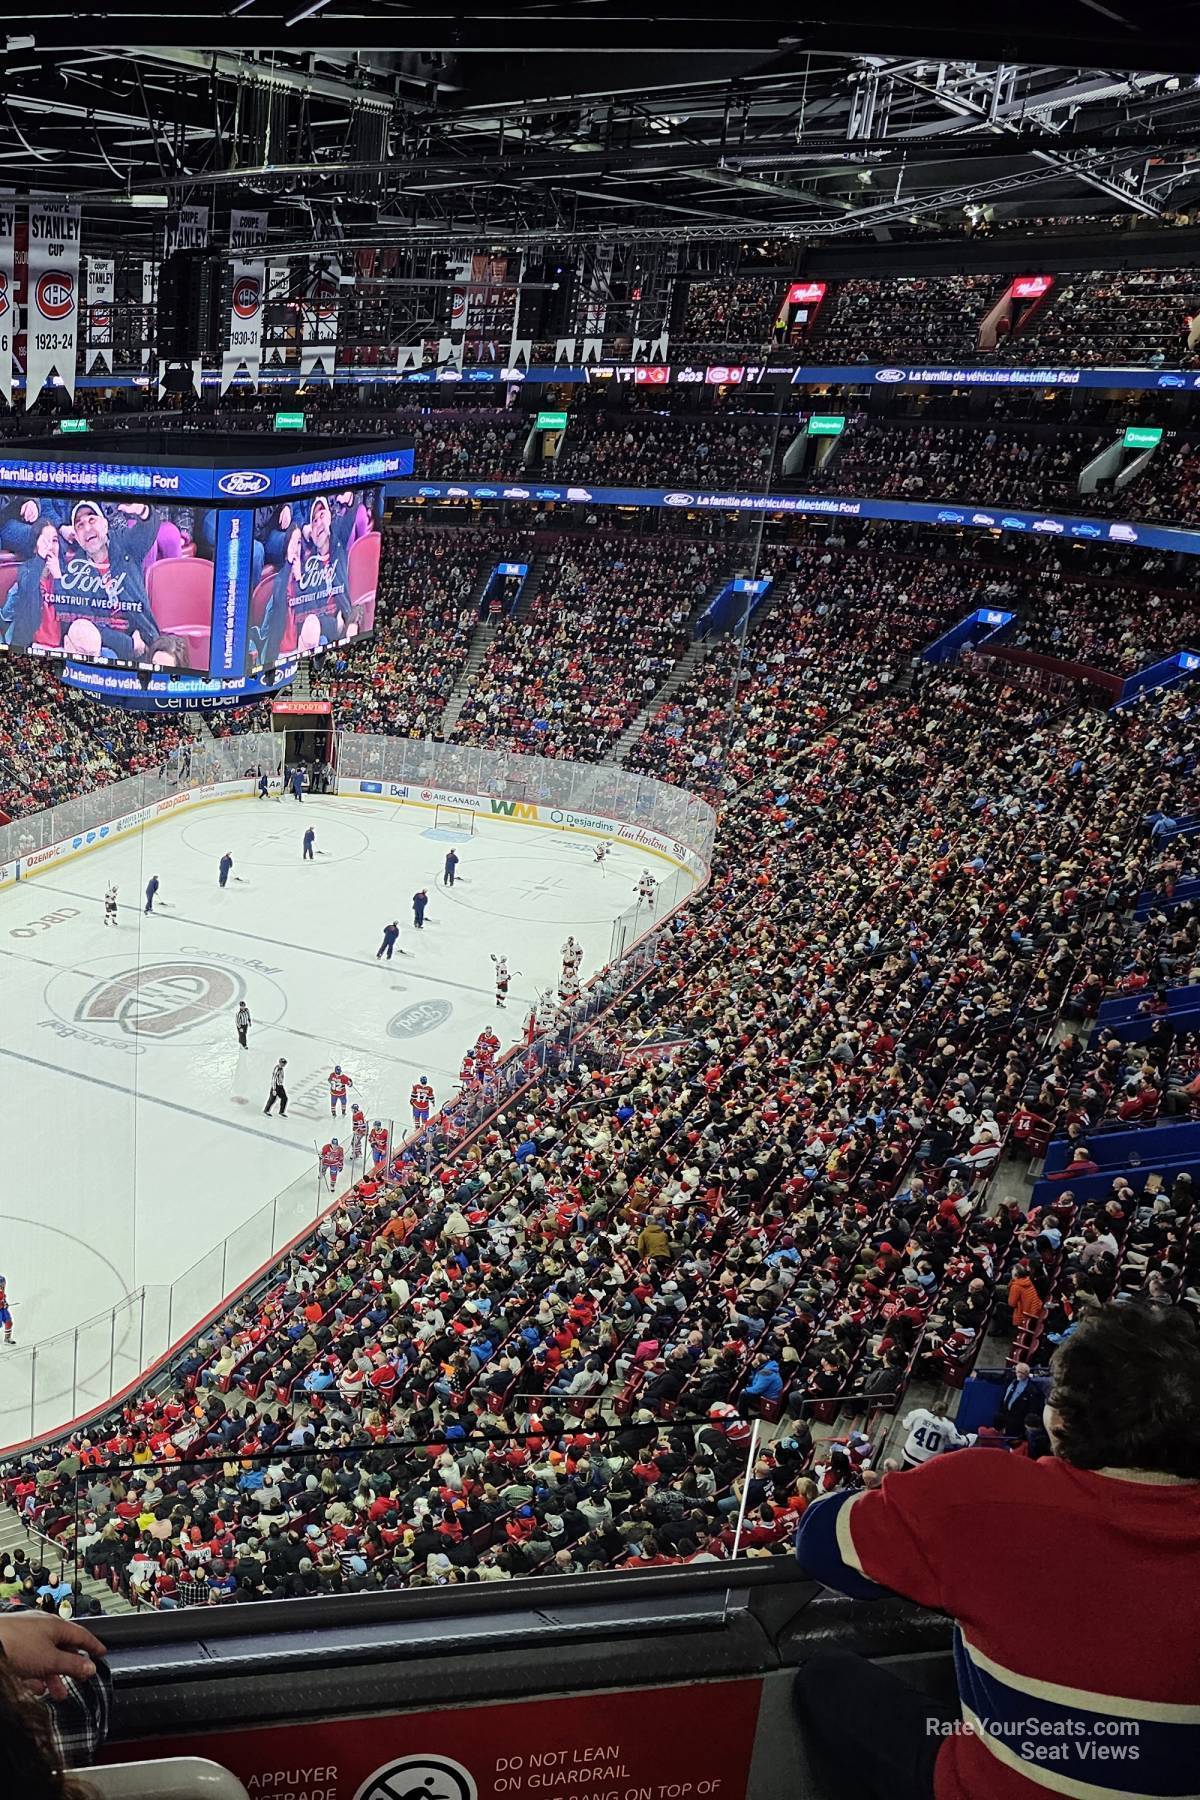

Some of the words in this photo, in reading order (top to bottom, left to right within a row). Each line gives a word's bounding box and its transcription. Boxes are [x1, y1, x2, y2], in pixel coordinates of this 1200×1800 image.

[181, 213, 199, 225] OUPE
[239, 215, 259, 229] COUPE
[32, 215, 80, 240] STANLEY
[48, 243, 64, 256] CUP
[89, 272, 114, 285] STANLEY
[96, 286, 105, 294] CUP
[35, 334, 73, 350] 1923-24
[231, 331, 258, 346] 1930-31
[678, 371, 703, 382] 9:03
[878, 370, 903, 382] Ford
[909, 371, 921, 381] La
[921, 371, 953, 382] famille
[953, 372, 965, 381] de
[965, 371, 1009, 382] véhicules
[1010, 372, 1057, 382] électrifiés
[1058, 373, 1079, 383] Ford
[0, 467, 34, 482] famille
[35, 469, 48, 483] de
[48, 470, 97, 484] véhicules
[97, 472, 151, 487] électrifiés
[152, 475, 179, 489] Ford
[222, 474, 266, 492] Ford
[666, 494, 691, 505] Ford
[697, 496, 709, 505] La
[709, 496, 740, 507] famille
[740, 498, 753, 507] de
[753, 498, 795, 509] véhicules
[796, 500, 838, 512] électrifiés
[839, 503, 860, 513] Ford
[61, 559, 126, 597] Ford
[300, 554, 338, 591] Ford
[44, 594, 90, 607] CONSTRUIT
[70, 669, 78, 678] La
[78, 670, 104, 686] famille
[104, 677, 117, 688] de
[390, 784, 409, 798] Bell
[156, 799, 172, 816] pizza
[173, 793, 190, 808] pizza
[433, 793, 446, 802] AIR
[447, 796, 481, 807] CANADA
[491, 799, 538, 820] WM
[566, 814, 614, 832] Desjardins
[617, 824, 634, 839] Tim
[636, 829, 667, 853] Hortons
[673, 843, 687, 857] SN
[26, 907, 81, 930] CIBC
[1019, 1119, 1031, 1131] 14
[947, 1337, 957, 1347] 12
[914, 1427, 942, 1451] 40
[496, 1755, 523, 1772] DO
[529, 1750, 568, 1768] NOT
[573, 1745, 620, 1763] LEAN
[247, 1766, 338, 1789] APPUYER
[493, 1776, 521, 1792] ON
[527, 1765, 631, 1788] GUARDRAIL
[624, 1787, 652, 1800] ON
[657, 1783, 692, 1799] TOP
[696, 1779, 723, 1794] OF
